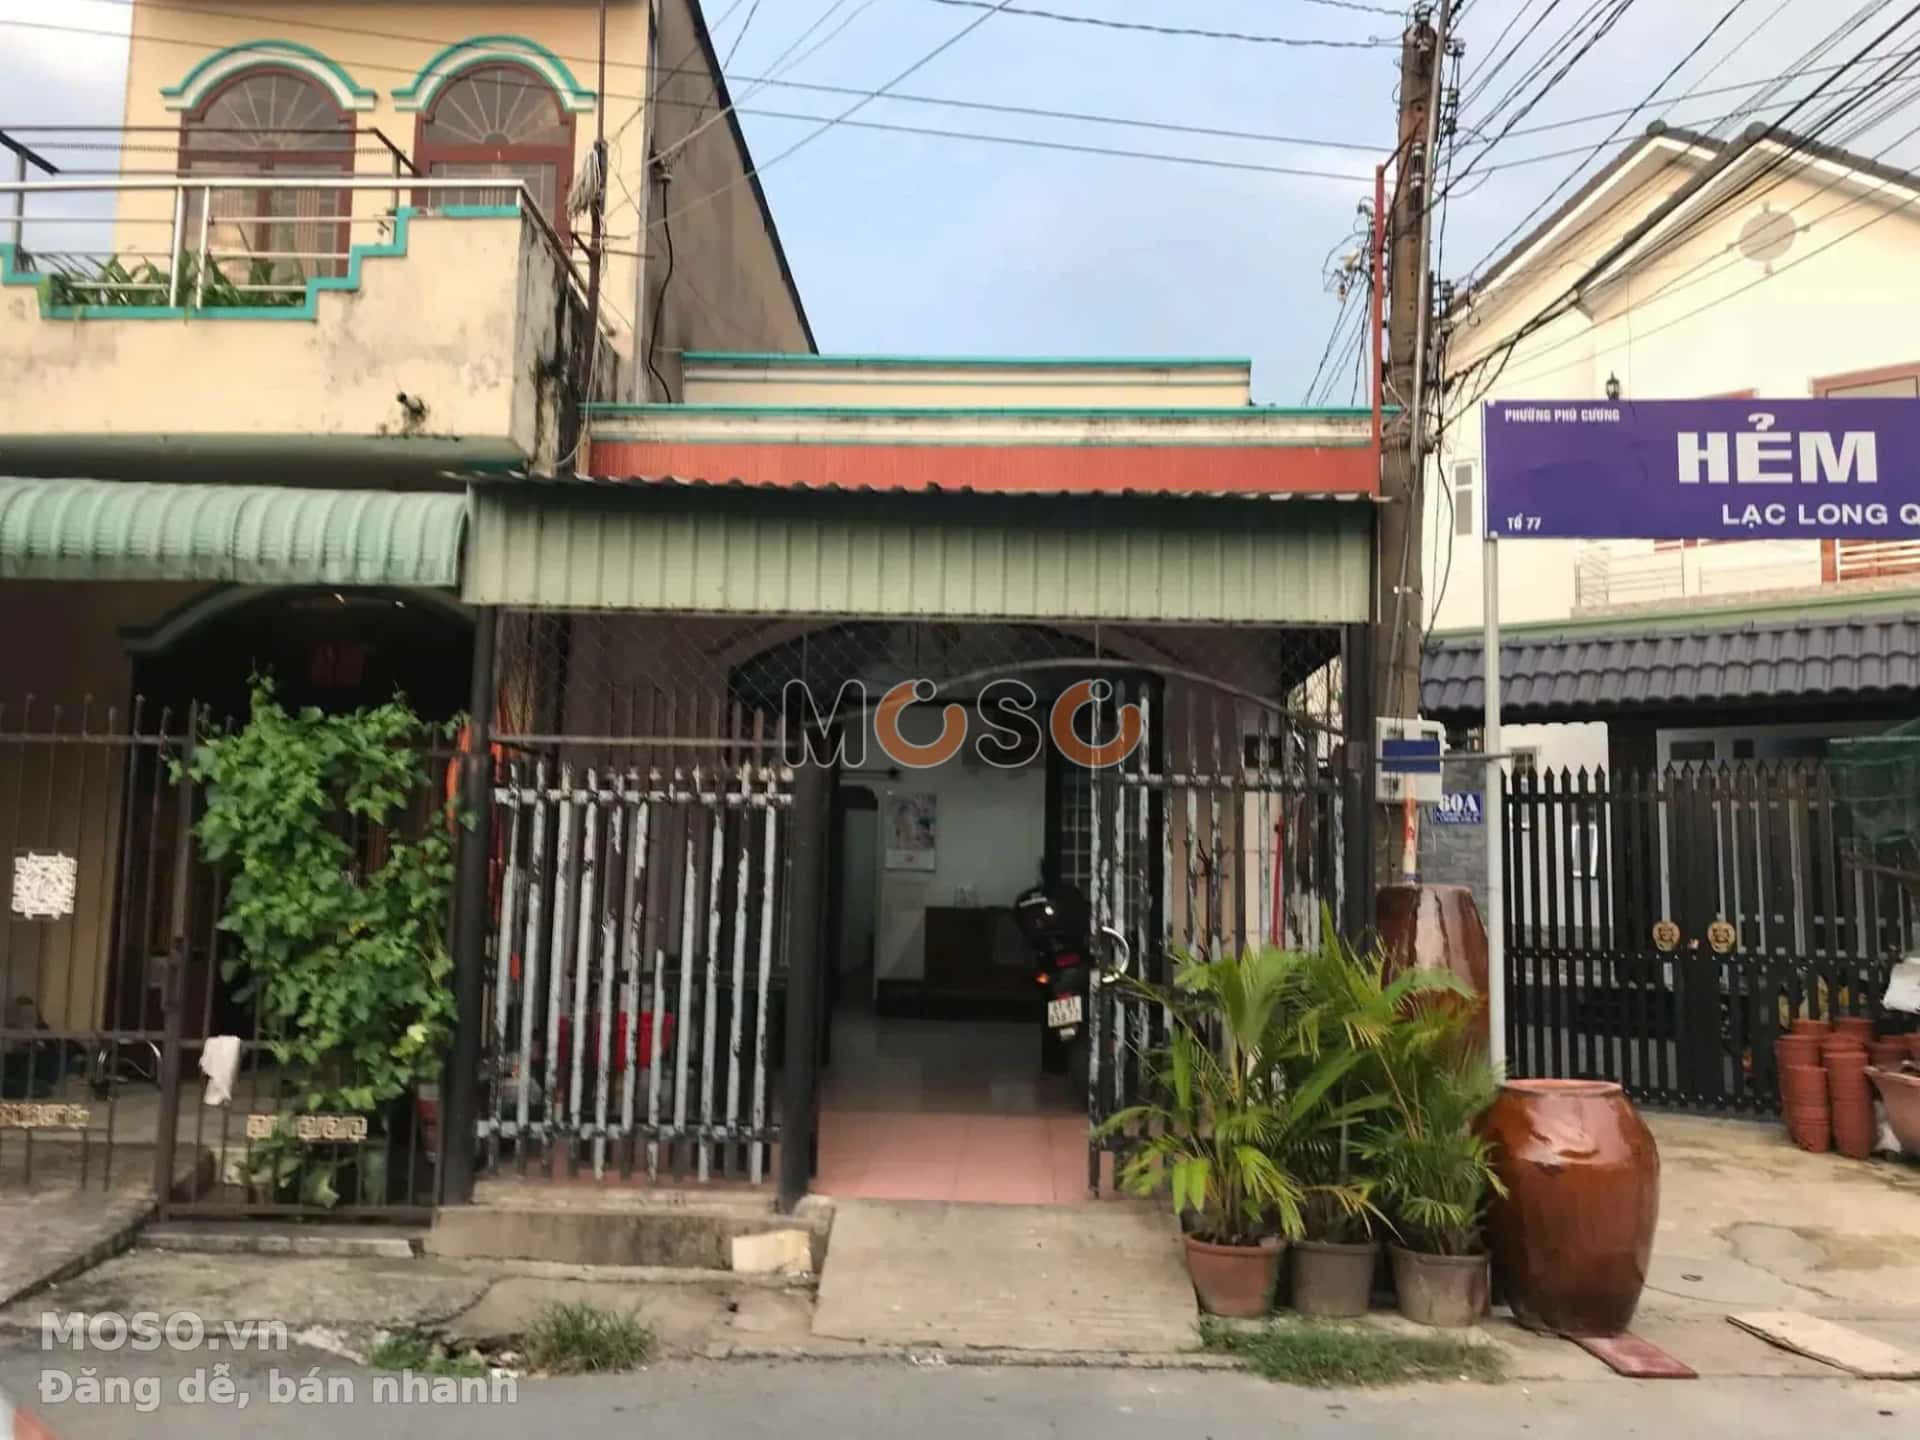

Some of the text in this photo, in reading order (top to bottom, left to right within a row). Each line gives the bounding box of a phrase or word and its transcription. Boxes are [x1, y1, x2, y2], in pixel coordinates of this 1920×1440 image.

[1677, 413, 1877, 483] HẺM
[1526, 516, 1541, 530] 77
[1722, 503, 1786, 529] LẠC
[1798, 503, 1888, 526] LONG
